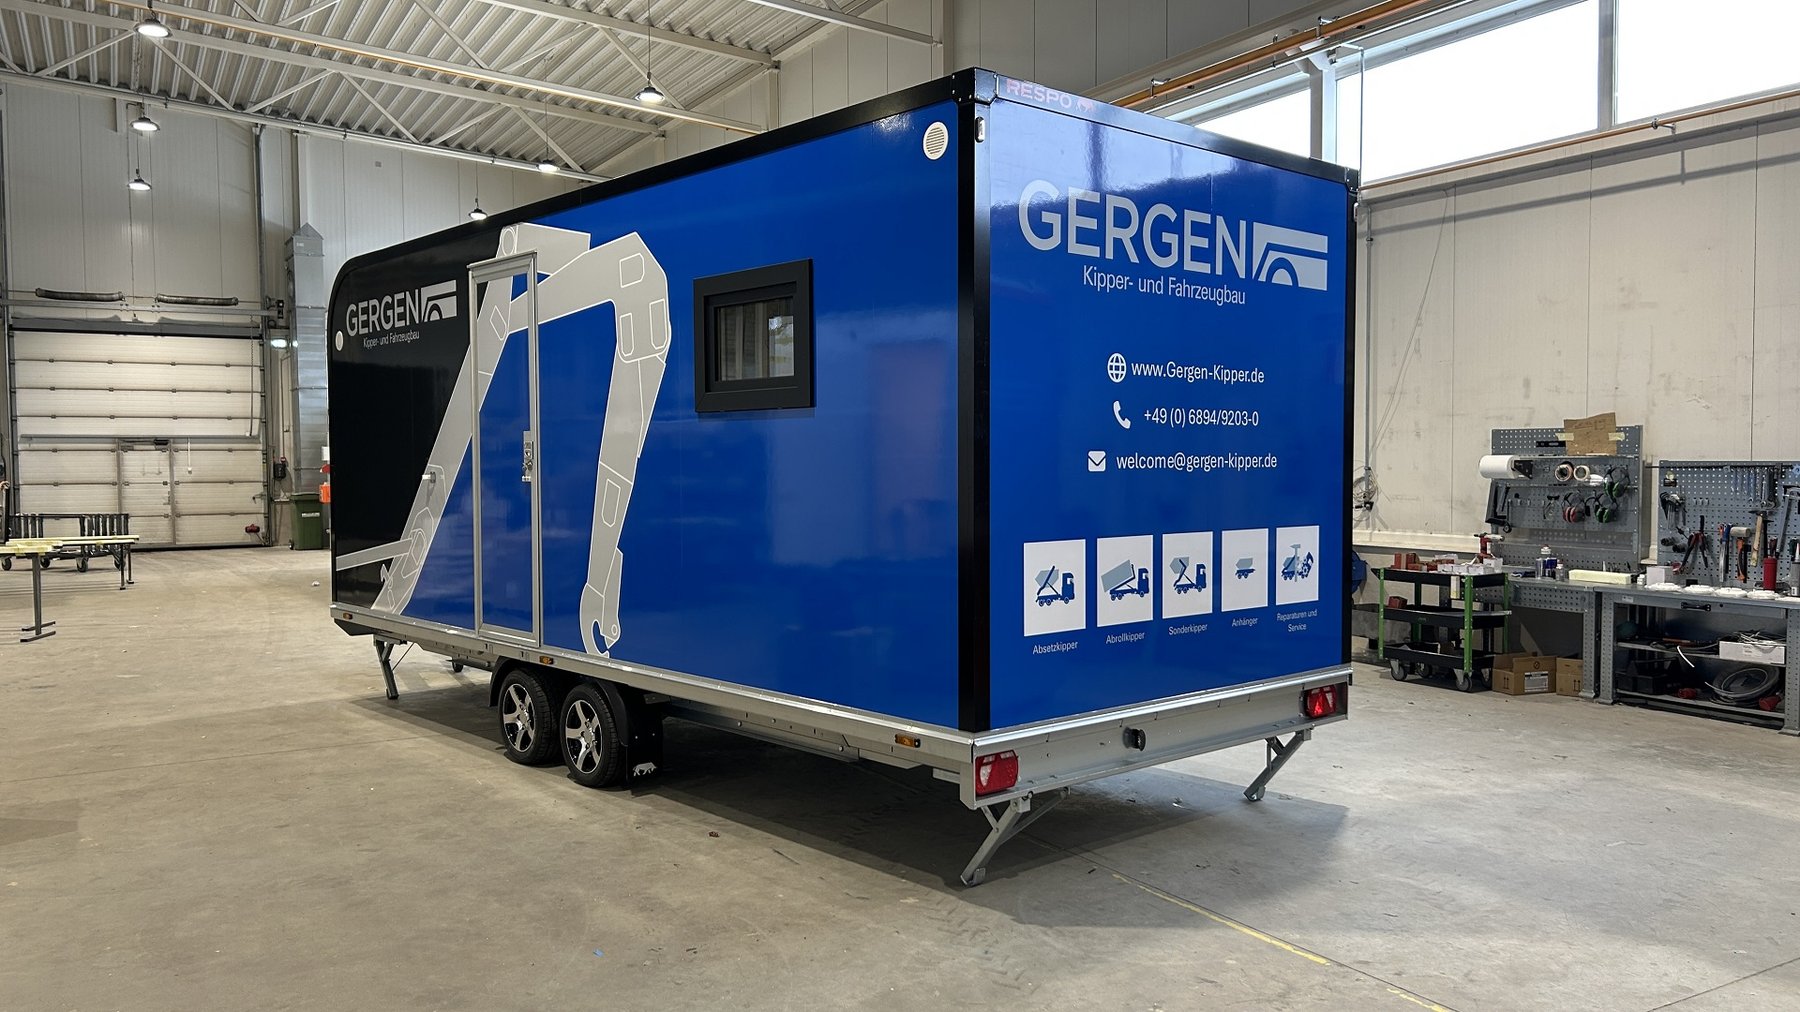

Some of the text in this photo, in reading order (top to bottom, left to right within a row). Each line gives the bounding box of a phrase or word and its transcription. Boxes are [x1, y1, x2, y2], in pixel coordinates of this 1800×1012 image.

[1006, 79, 1072, 109] RESPO
[1018, 179, 1246, 279] GERGEN
[1083, 264, 1246, 307] Kipper- und Fahrzeugbau
[346, 289, 419, 336] GERGEN
[363, 329, 420, 350] Kipper- und Fahrzeugbau
[1131, 361, 1265, 385] www.Gergen-Kipper.de
[1144, 407, 1259, 428] +49 (0) 6894/9203-0
[1116, 452, 1278, 473] welcome@gergen-kipper.de
[1231, 617, 1259, 627] Anhänger
[1276, 608, 1318, 622] Reparaturen und
[1168, 623, 1208, 636] Sonderkipper
[1287, 623, 1307, 632] Service
[1032, 641, 1078, 655] Absetzkipper
[1105, 632, 1146, 645] Abrollkipper
